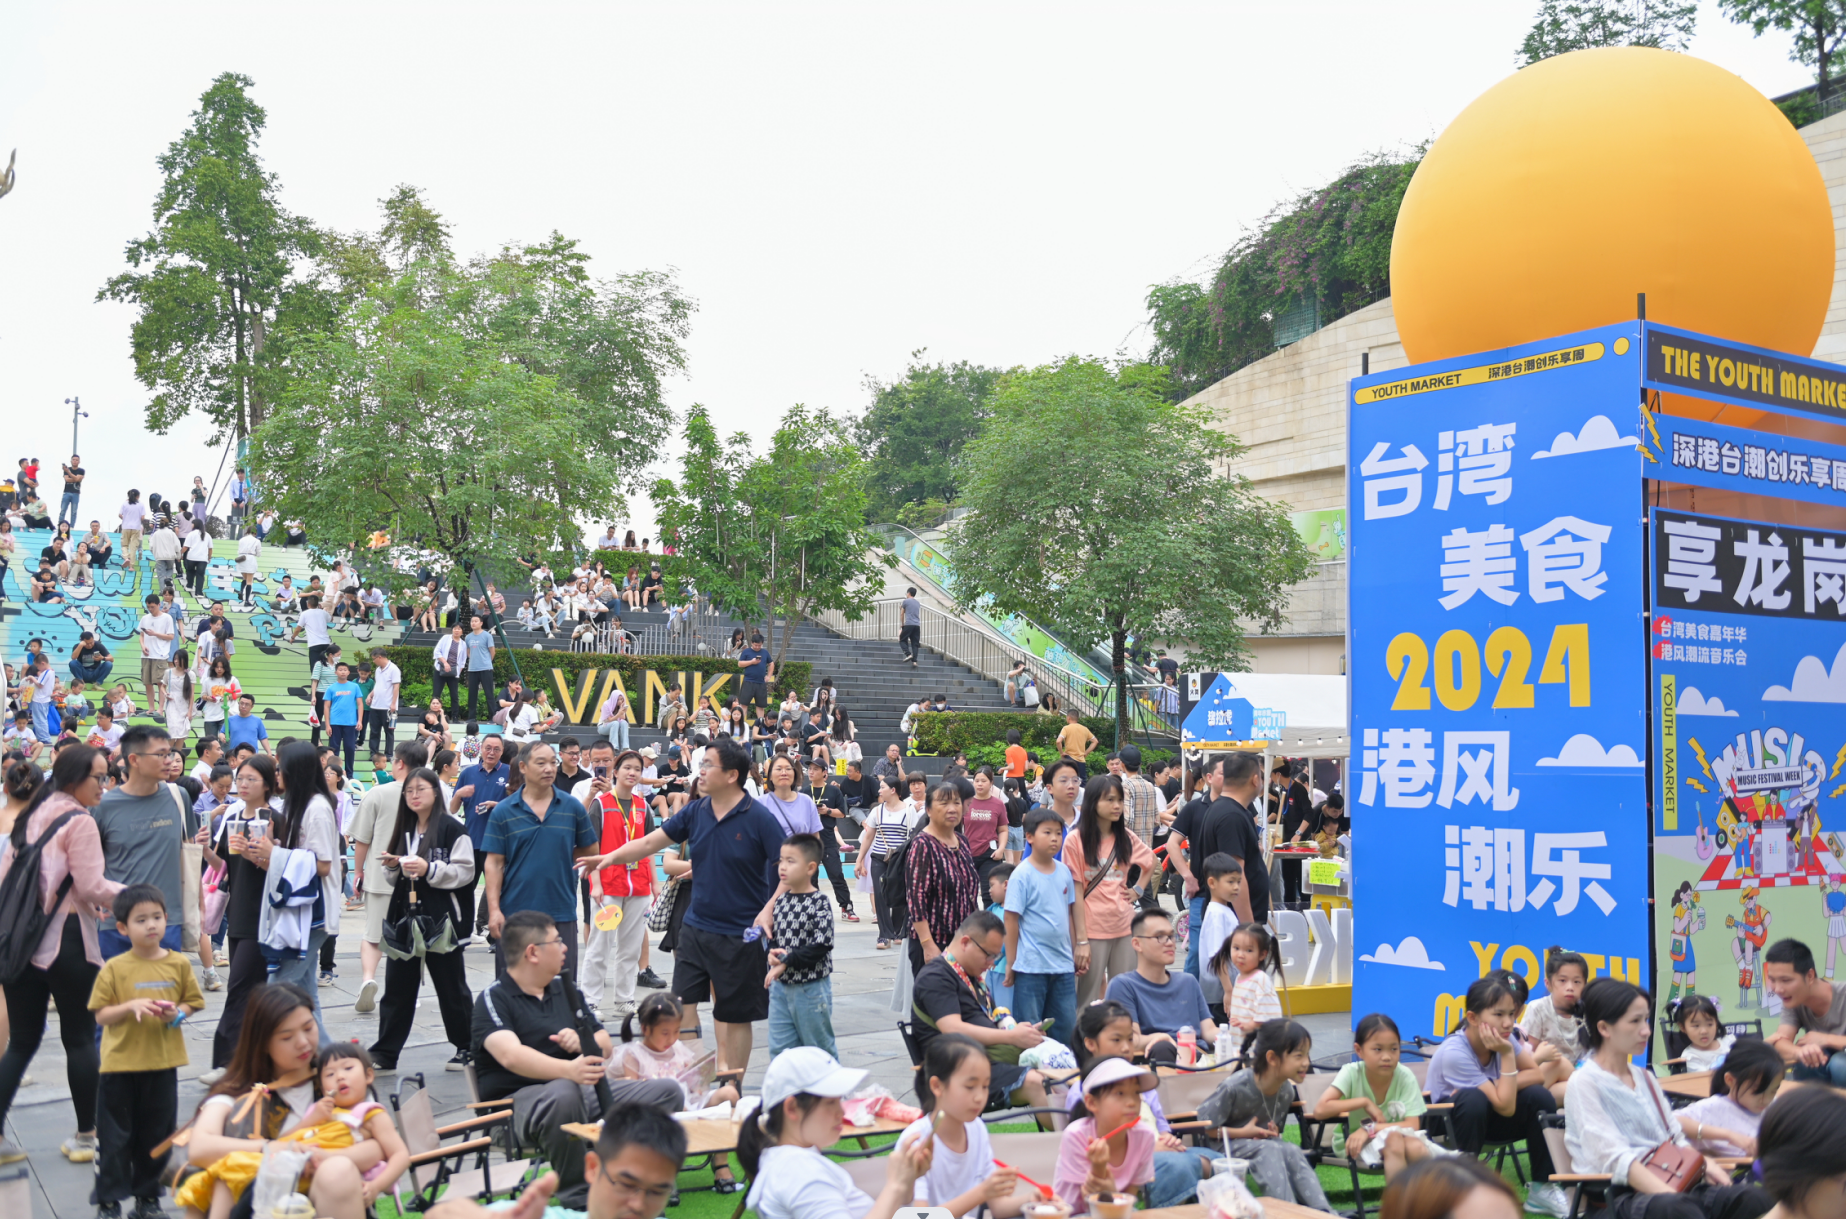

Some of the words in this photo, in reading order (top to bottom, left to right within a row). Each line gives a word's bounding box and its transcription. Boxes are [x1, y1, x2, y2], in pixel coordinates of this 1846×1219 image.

[1372, 382, 1408, 399] YOUTH
[1410, 373, 1462, 393] MARKET
[1488, 348, 1585, 380] 深港台潮创乐享周
[1661, 345, 1700, 380] THE
[1705, 354, 1774, 395] YOUTH
[1780, 371, 1846, 410] MARKE
[1360, 422, 1516, 521] 台湾
[1672, 432, 1846, 491] 深港台潮创乐享周
[1438, 515, 1613, 611] 美食
[1664, 520, 1846, 615] 享龙岗
[1660, 620, 1748, 643] 台湾美食嘉年华
[1661, 643, 1748, 666] 港风潮流音乐会
[1386, 623, 1590, 711] 2024
[1258, 712, 1285, 727] YOUTH
[1663, 682, 1674, 737] YOUTH
[1358, 728, 1520, 811] 港风
[1664, 748, 1675, 813] MARKET
[1737, 774, 1757, 786] MUSIC
[1758, 773, 1784, 785] FESTIVAL
[1785, 771, 1801, 782] WEEK
[1442, 825, 1617, 917] 潮乐
